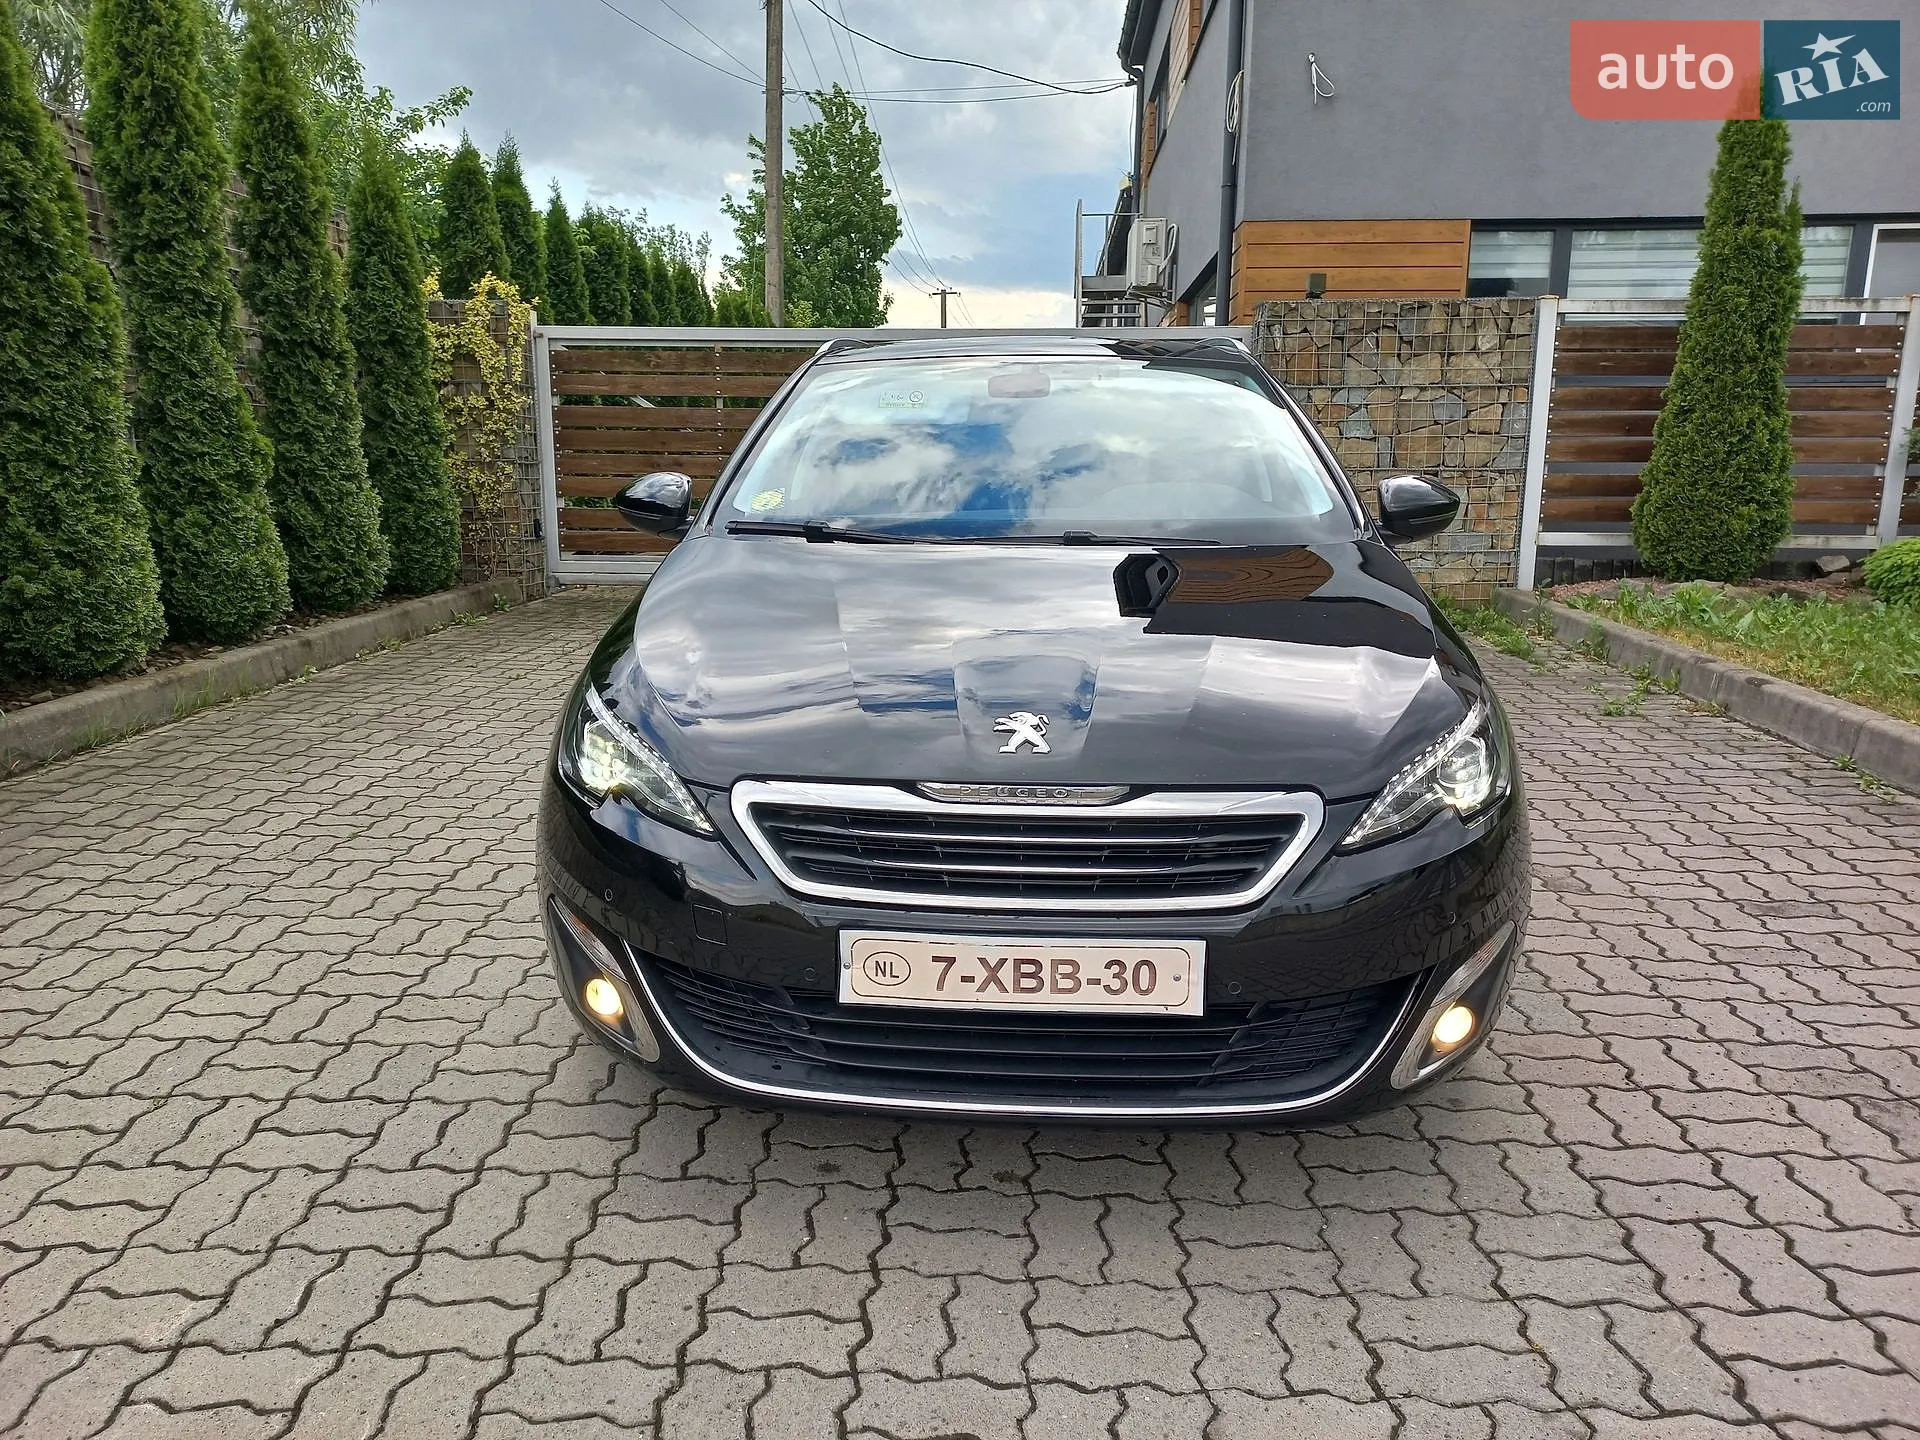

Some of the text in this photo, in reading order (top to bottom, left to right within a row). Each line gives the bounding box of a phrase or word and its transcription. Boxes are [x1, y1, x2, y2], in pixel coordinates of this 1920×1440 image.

[959, 785, 1084, 798] PEUGEOT
[874, 956, 1157, 996] NL 7-XBB-30
